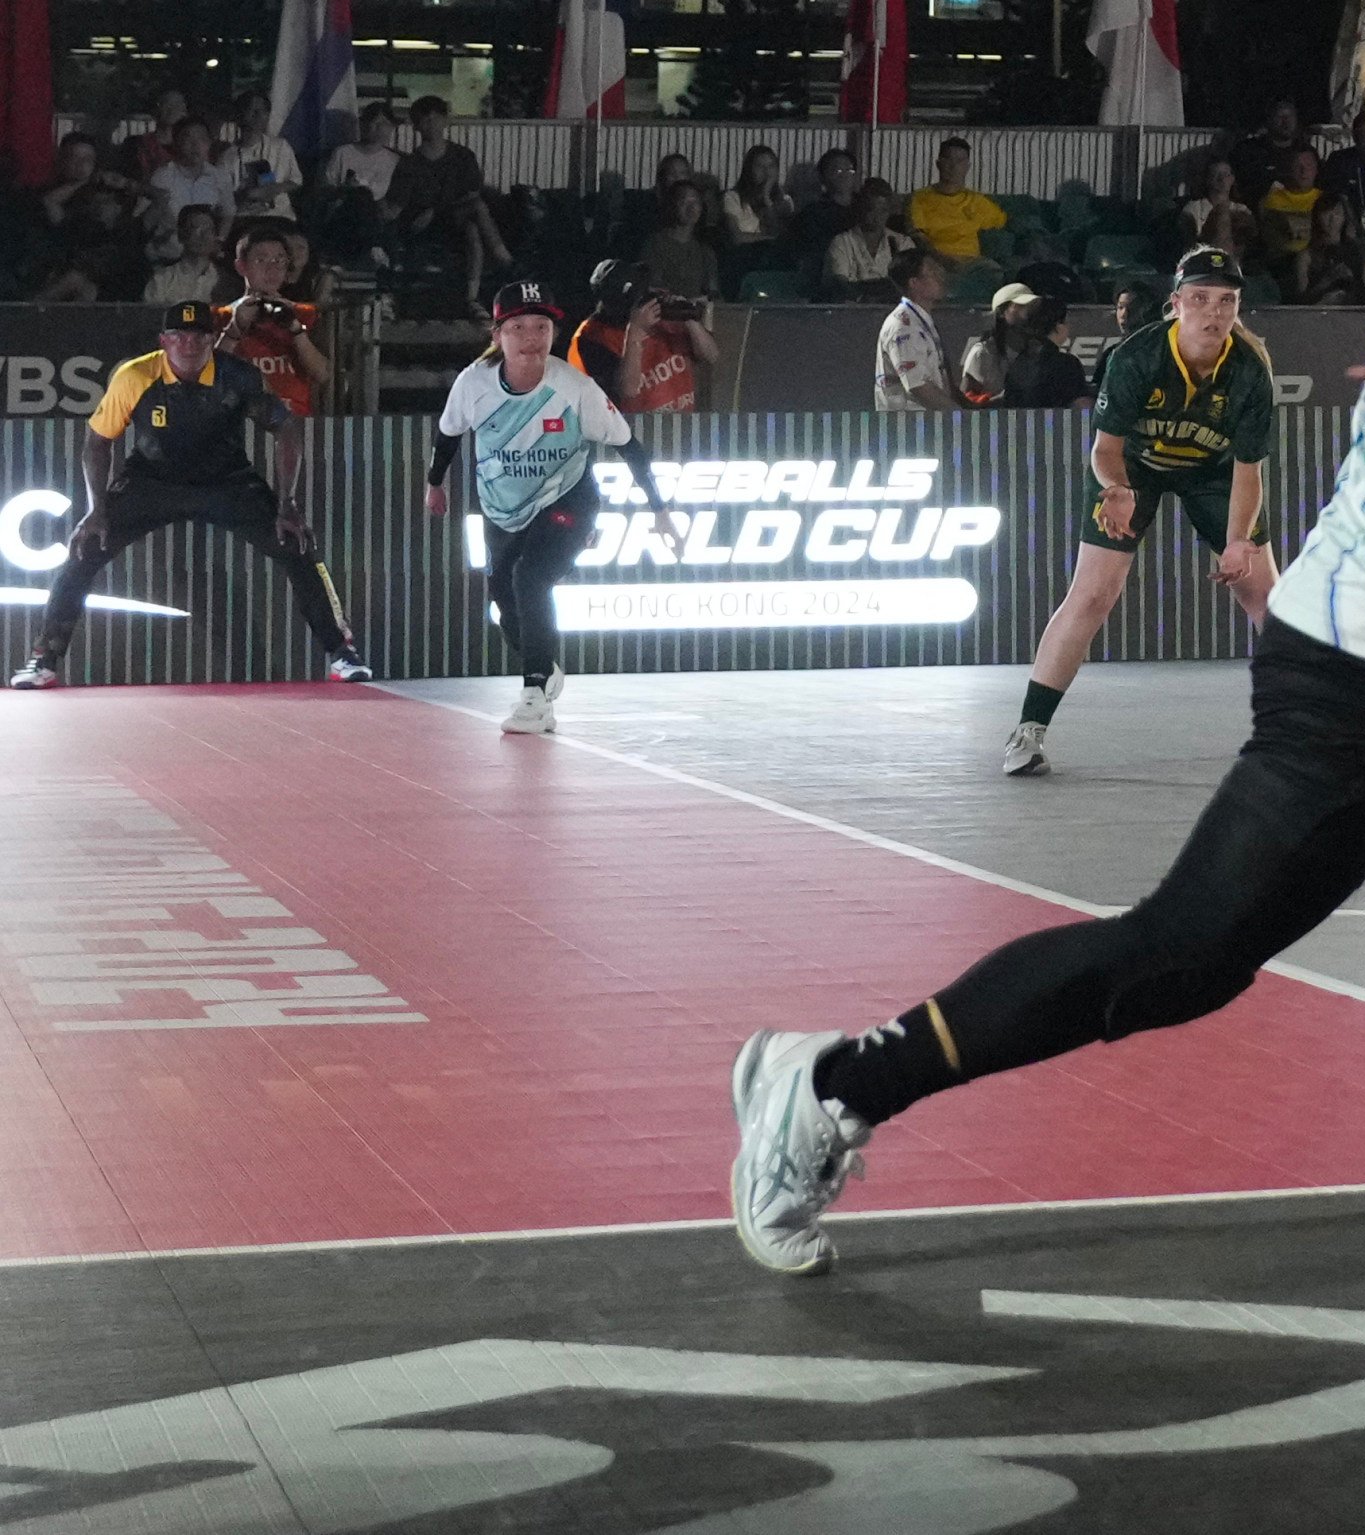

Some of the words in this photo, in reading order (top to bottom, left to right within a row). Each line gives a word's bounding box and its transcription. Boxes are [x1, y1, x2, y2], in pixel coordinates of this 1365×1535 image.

[637, 354, 687, 392] HOTO
[503, 464, 546, 478] CHINA
[803, 506, 1001, 562] CUP
[587, 594, 683, 620] HONG
[698, 592, 789, 619] KONG
[803, 591, 883, 615] 2024
